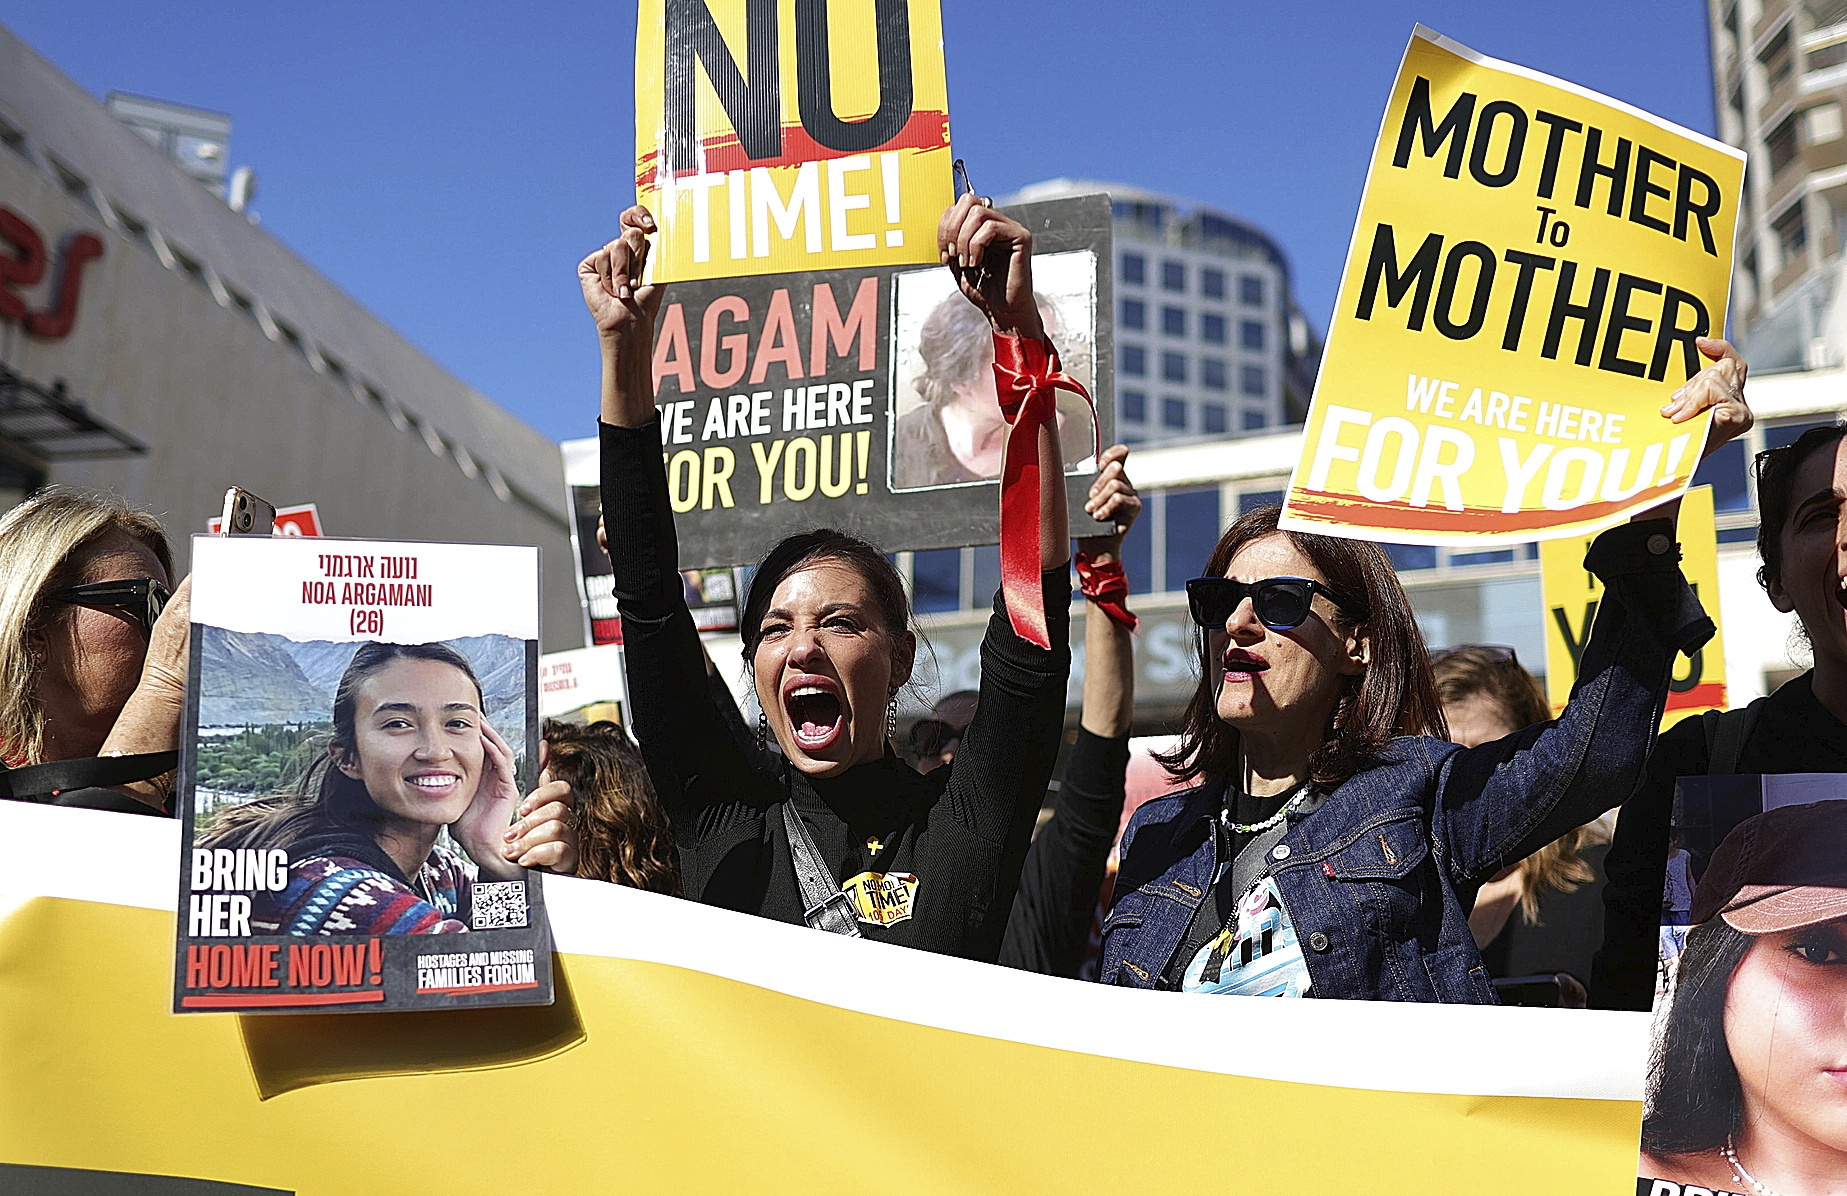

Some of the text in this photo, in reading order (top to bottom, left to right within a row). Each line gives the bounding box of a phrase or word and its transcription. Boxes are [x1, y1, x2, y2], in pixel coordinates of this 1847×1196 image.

[664, 0, 913, 172] NO
[1392, 75, 1721, 258] MOTHER
[675, 152, 904, 264] TIME!
[1355, 223, 1711, 382] MOTHER
[653, 276, 878, 396] AGAM
[701, 391, 773, 441] ARE
[782, 379, 874, 432] HERE
[1407, 374, 1626, 444] WE ARE HERE
[663, 430, 871, 513] OR YOU!
[1306, 404, 1691, 515] FOR YOU!
[302, 581, 432, 607] NOA ARGAMANI
[318, 554, 418, 579] נועה ארגמני
[350, 608, 384, 636] (26)
[190, 848, 289, 892] BRING
[188, 894, 252, 937] HER
[887, 904, 909, 920] DAY
[185, 938, 384, 989] HOME NOW!
[417, 949, 534, 969] HOSTAGES AND MISSING
[418, 963, 536, 989] FAMILIES FORUM
